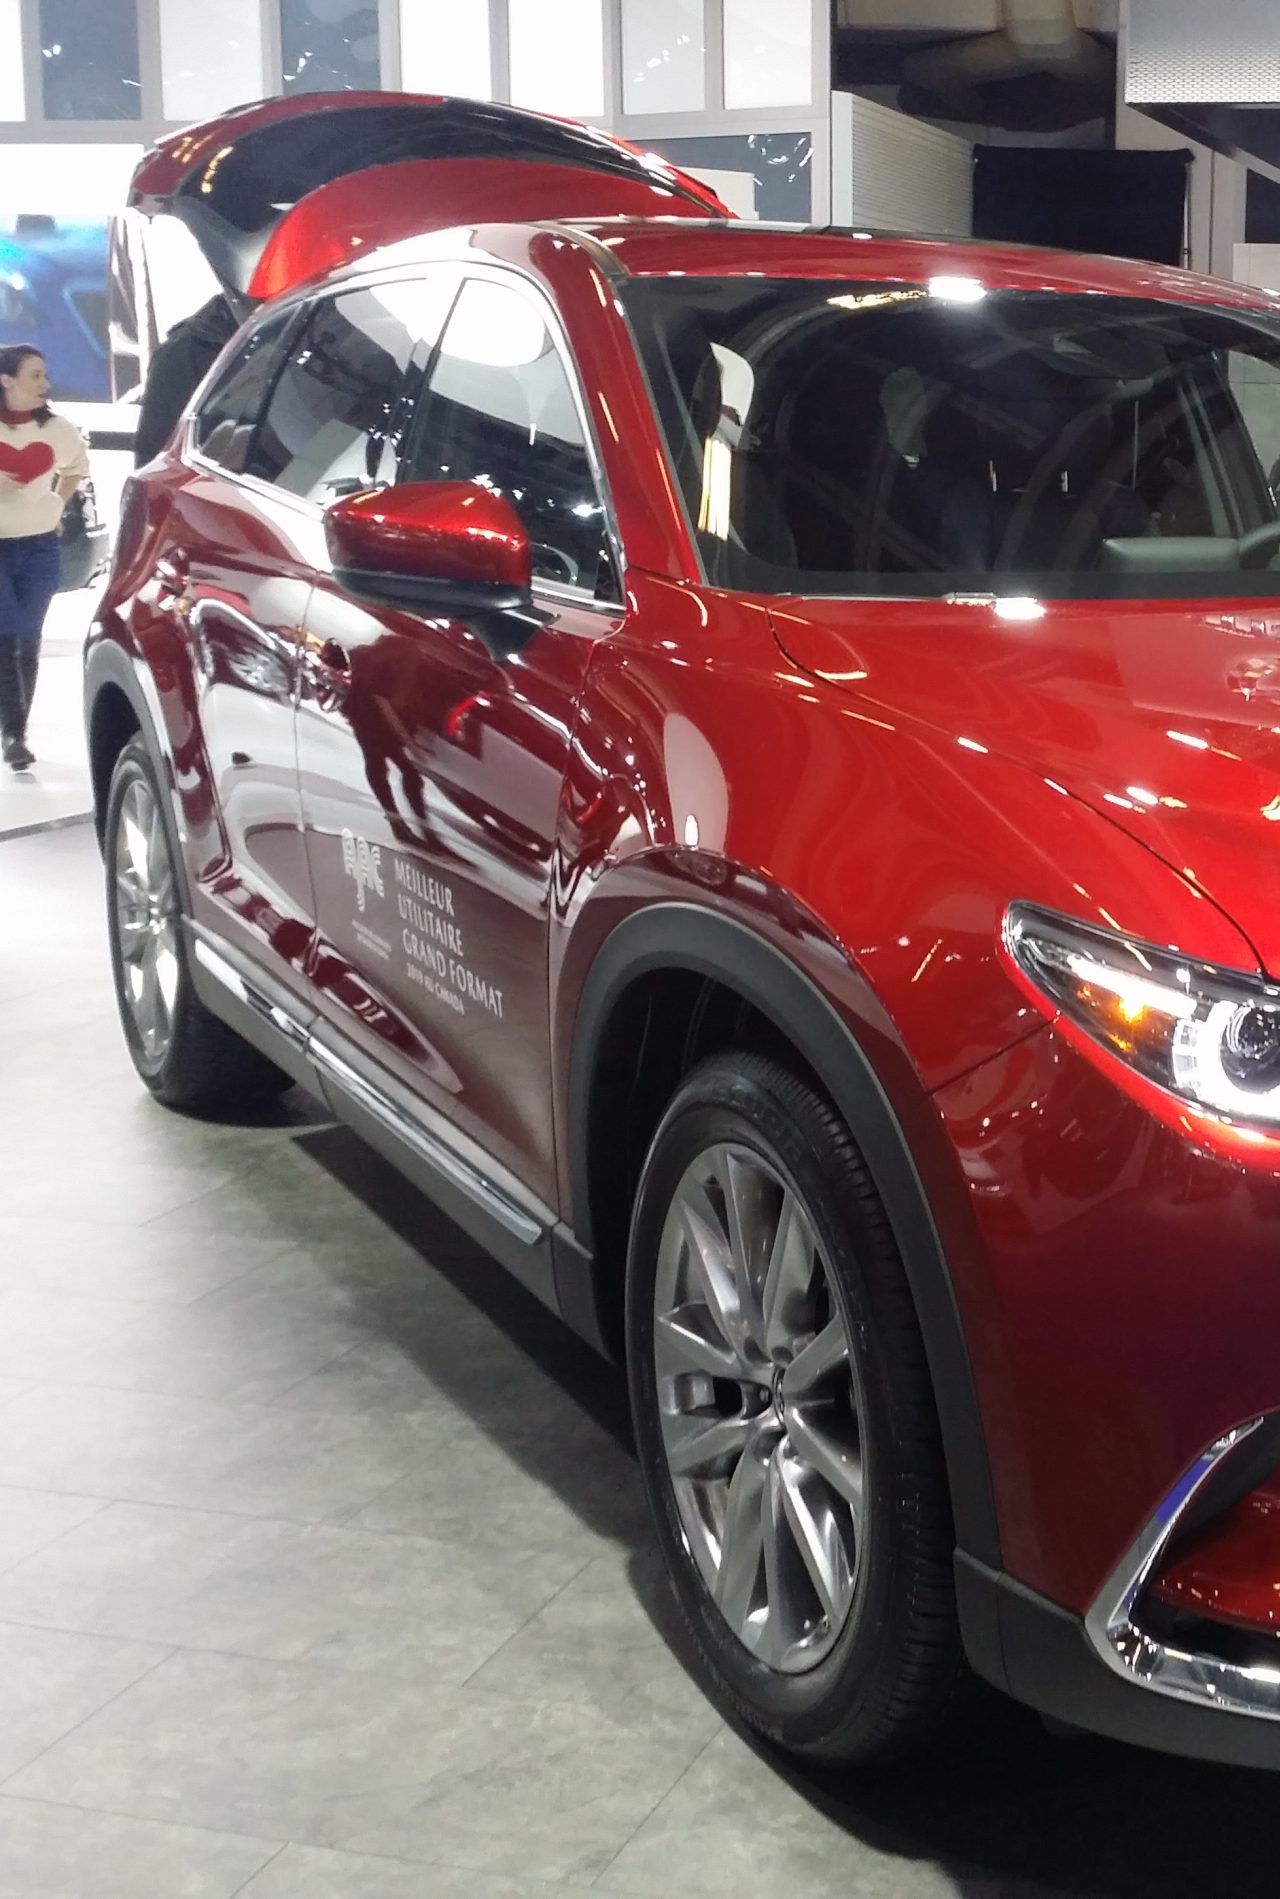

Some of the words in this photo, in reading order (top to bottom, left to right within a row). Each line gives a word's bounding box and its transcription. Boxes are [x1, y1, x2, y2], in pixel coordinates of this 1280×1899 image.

[394, 857, 455, 917] MEILLEUR
[398, 893, 464, 956] UTILITAIRE
[402, 927, 447, 977] GRAND
[448, 958, 503, 1018] FORMAT
